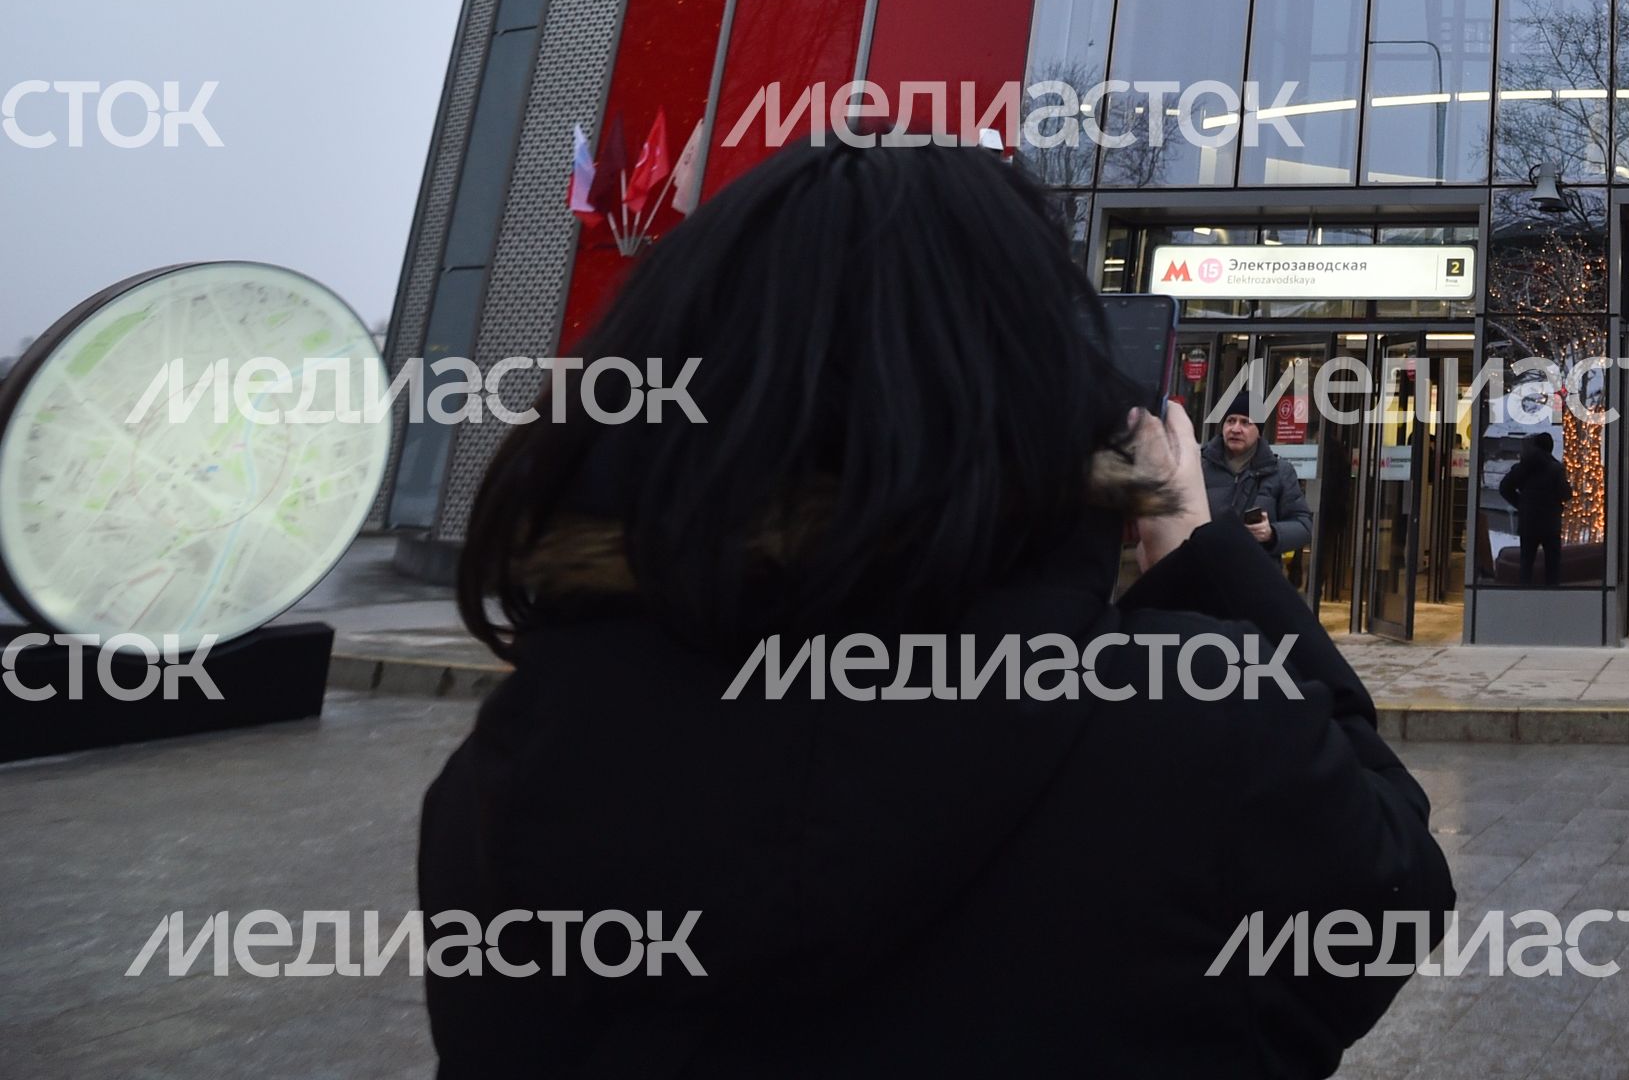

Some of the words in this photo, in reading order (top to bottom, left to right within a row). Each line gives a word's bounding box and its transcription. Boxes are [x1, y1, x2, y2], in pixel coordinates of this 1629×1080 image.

[1202, 263, 1219, 279] 15
[1228, 258, 1368, 274] Электрозаводская
[1451, 261, 1460, 274] 2
